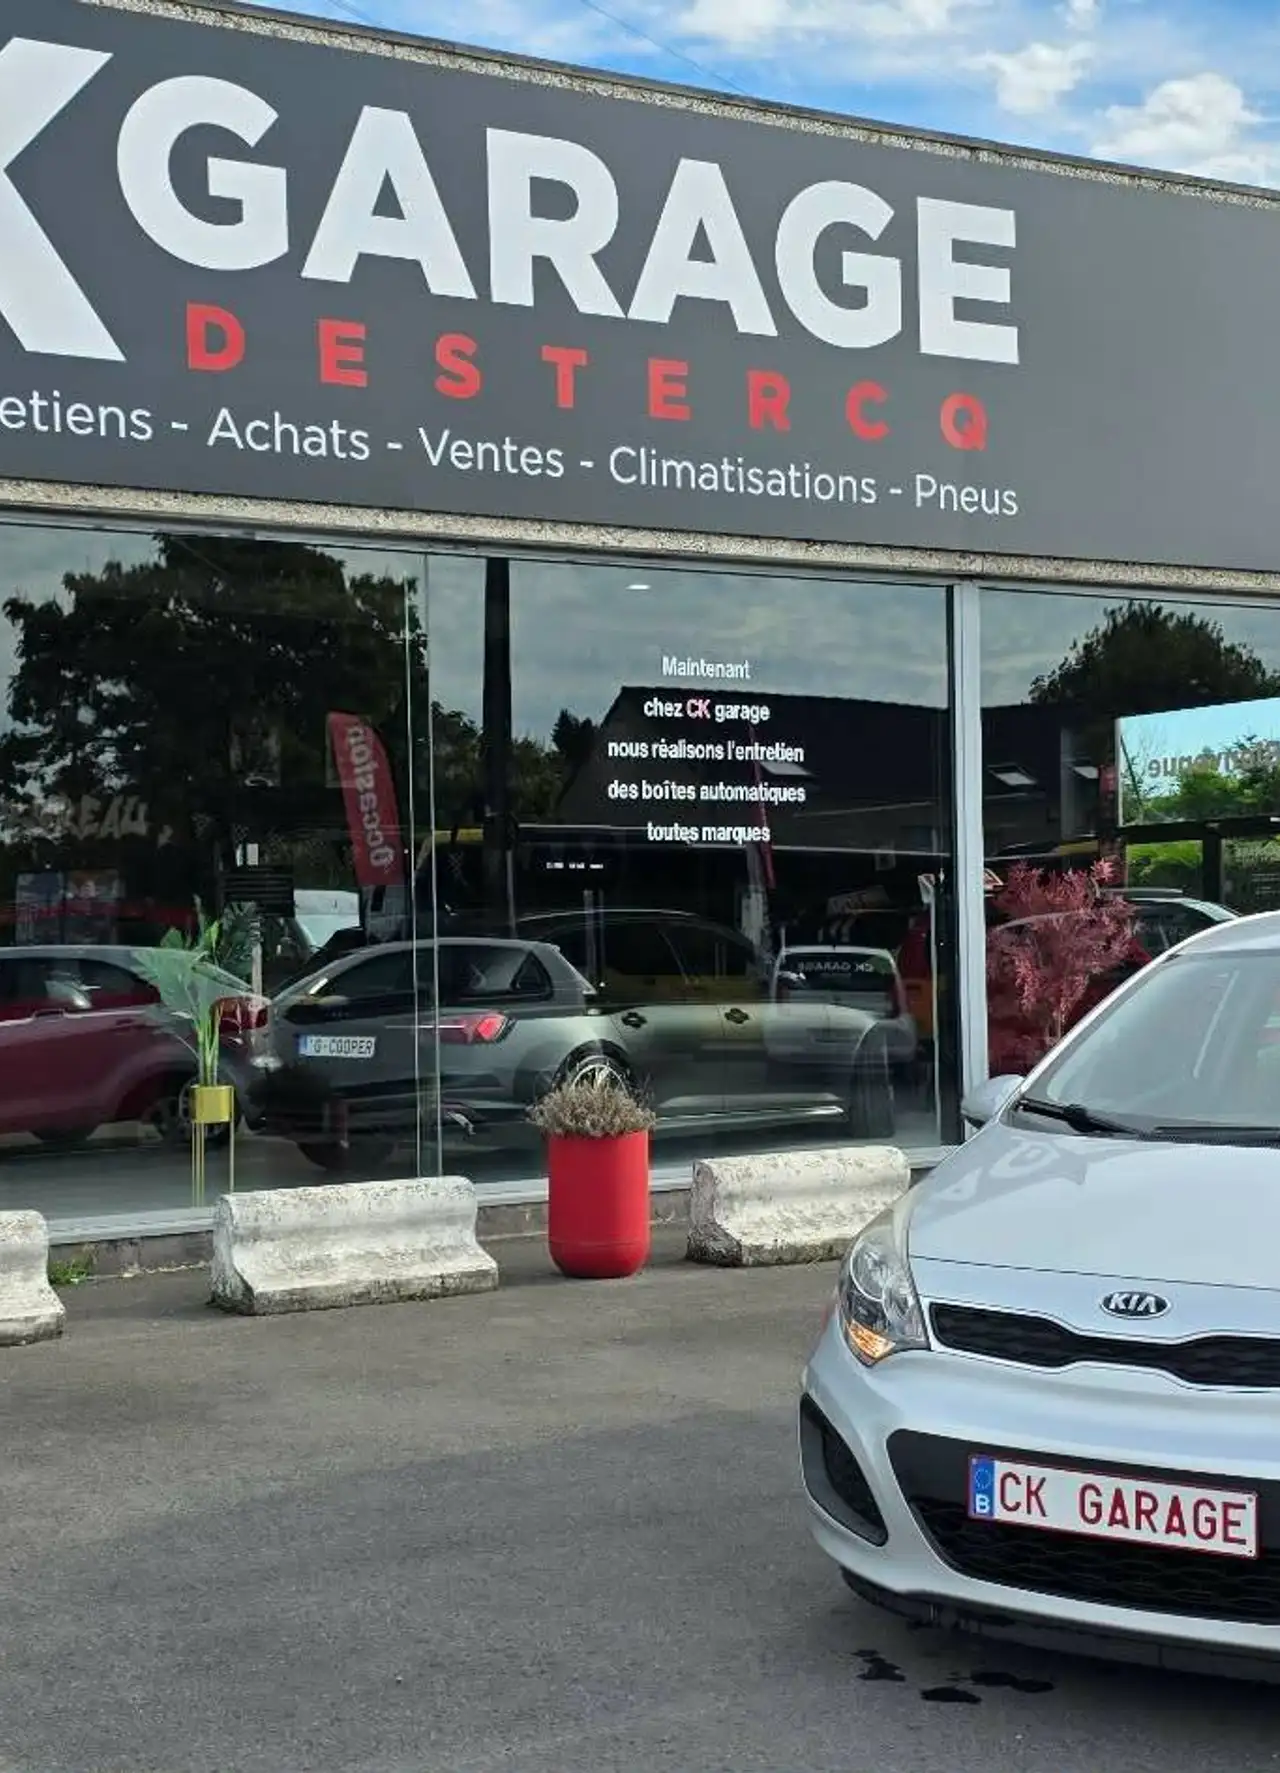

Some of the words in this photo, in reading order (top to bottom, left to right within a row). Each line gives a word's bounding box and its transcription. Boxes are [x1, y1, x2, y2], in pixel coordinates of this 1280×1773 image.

[117, 75, 1019, 365] GARAGE
[186, 304, 988, 450] DESTERCQ
[207, 407, 370, 461] Achats
[418, 427, 564, 478] Ventes
[609, 446, 877, 504] Climatisations
[915, 474, 1019, 516] Pneus
[662, 656, 751, 680] Maintenant
[643, 698, 684, 718] chez
[686, 699, 711, 719] CK
[715, 703, 770, 724] garage
[607, 742, 649, 758] nous
[652, 738, 723, 760] réalisons
[727, 741, 805, 762] l'entretien
[607, 780, 639, 799] des
[642, 780, 696, 801] boîtes
[700, 782, 806, 805] automatiques
[647, 822, 699, 842] toutes
[702, 825, 770, 845] marques
[1109, 1293, 1157, 1313] KIA
[975, 1493, 991, 1514] B
[999, 1471, 1048, 1518] CK
[1078, 1483, 1247, 1545] GARAGE
